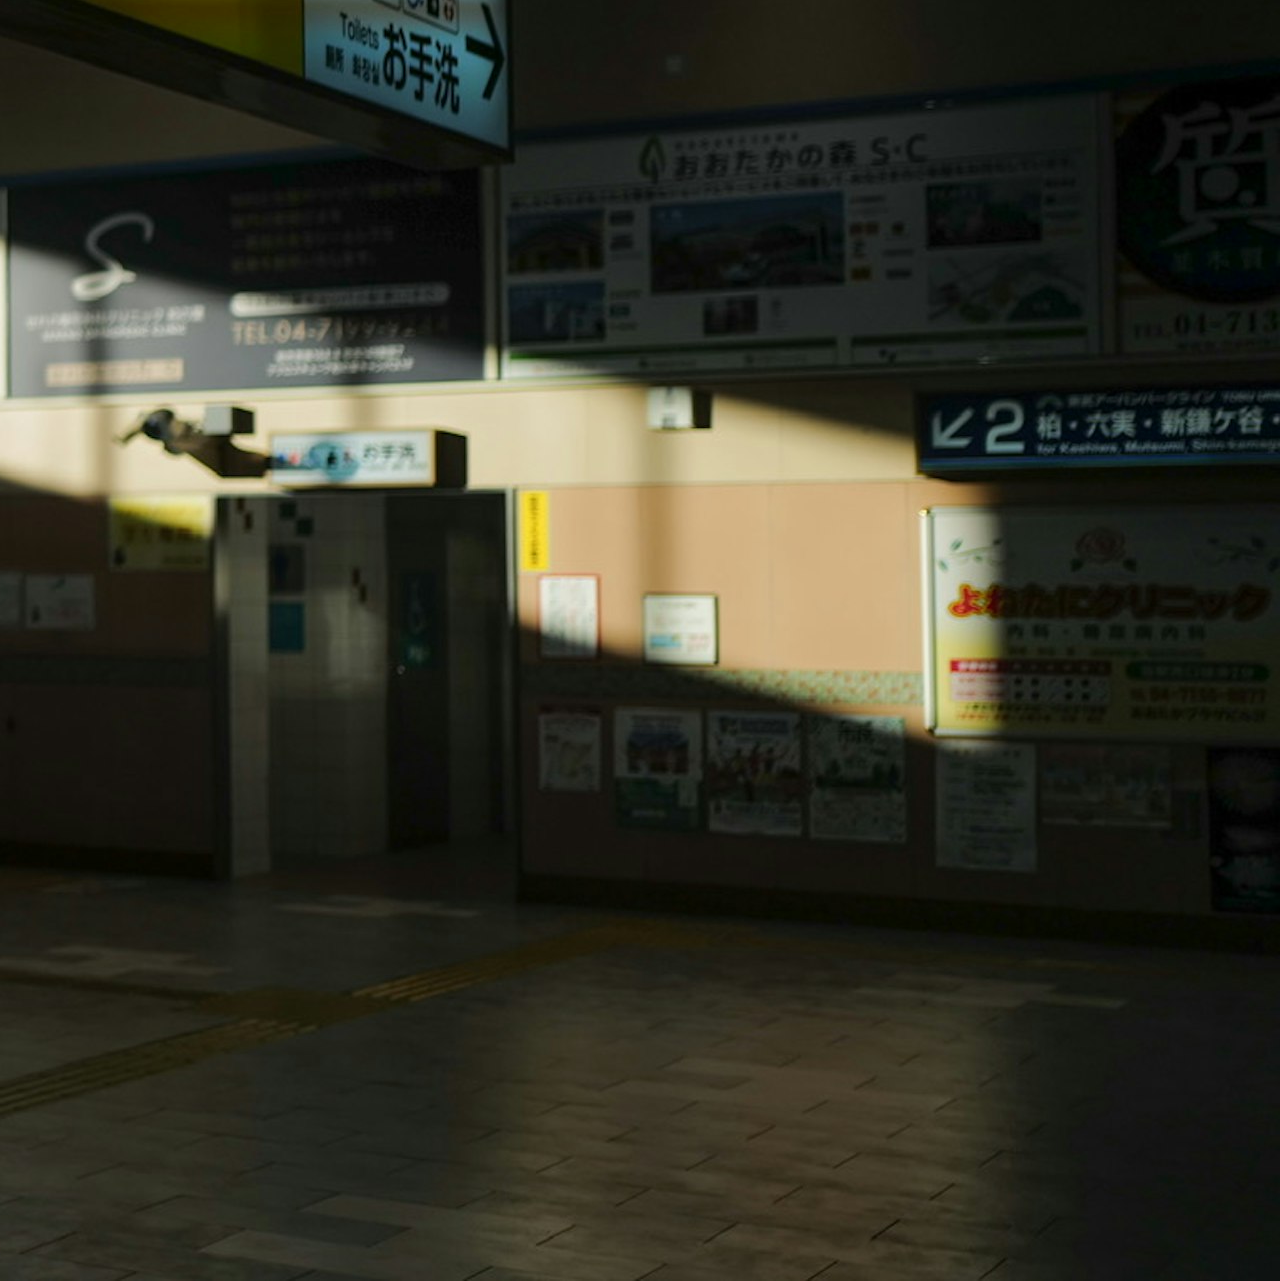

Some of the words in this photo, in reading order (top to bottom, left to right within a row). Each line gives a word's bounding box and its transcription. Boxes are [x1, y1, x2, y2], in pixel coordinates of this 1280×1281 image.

[339, 10, 380, 51] Toilets
[383, 24, 460, 114] お手洗
[673, 138, 857, 182] おおたかの森
[984, 398, 1027, 454] 2
[948, 583, 1272, 622] よねたにクリニック
